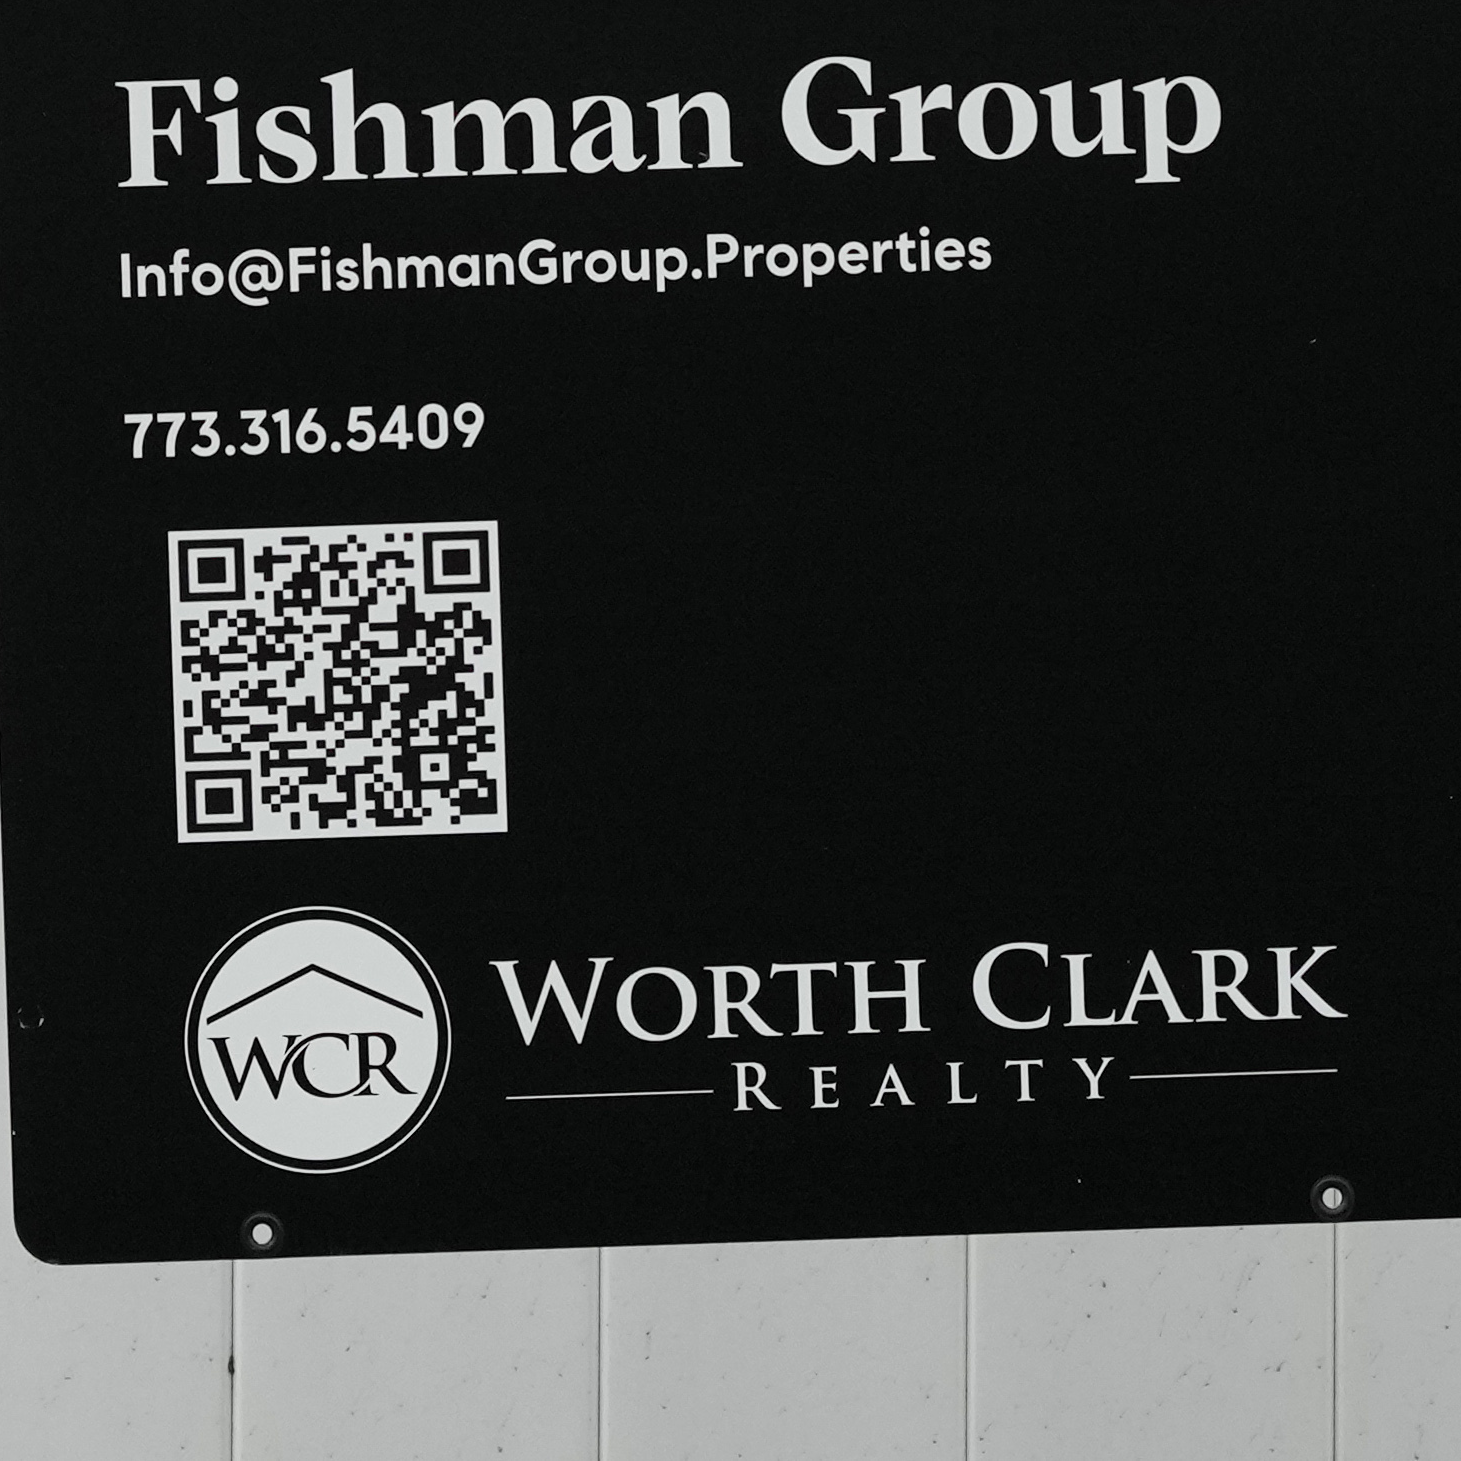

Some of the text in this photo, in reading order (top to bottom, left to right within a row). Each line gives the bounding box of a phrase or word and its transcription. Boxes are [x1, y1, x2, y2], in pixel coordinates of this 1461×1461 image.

[114, 56, 1222, 188] Fishman Group
[120, 226, 992, 307] Info@FishmanGroup.Properties
[123, 401, 485, 459] 773.316.5409
[488, 941, 1349, 1046] WORTH CLARK
[207, 1032, 418, 1102] WCR
[730, 1056, 1115, 1112] REALTY
